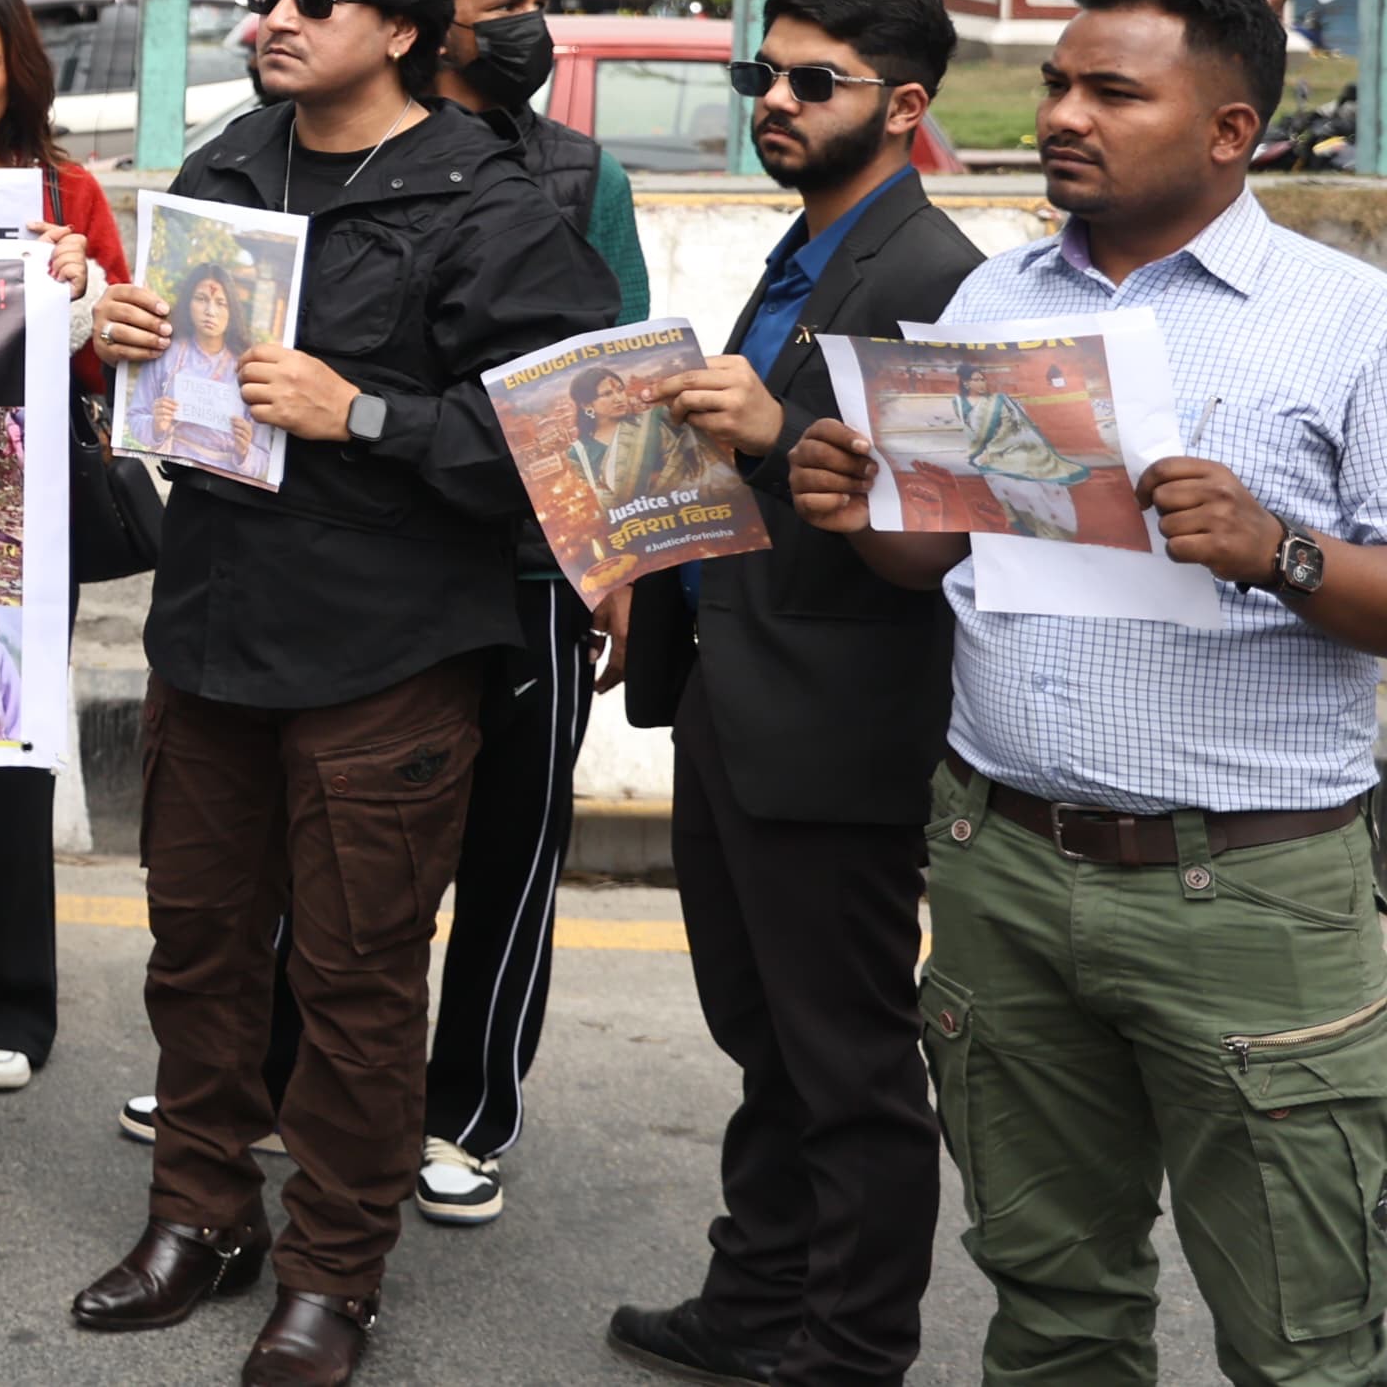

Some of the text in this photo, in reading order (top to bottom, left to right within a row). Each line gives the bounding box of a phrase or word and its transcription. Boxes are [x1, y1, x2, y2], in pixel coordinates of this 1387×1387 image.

[503, 327, 685, 391] ENOUGH IS ENOUGH
[608, 487, 699, 524] Justice for
[607, 515, 676, 550] इनिशा
[645, 528, 735, 553] #JusticeForInisha
